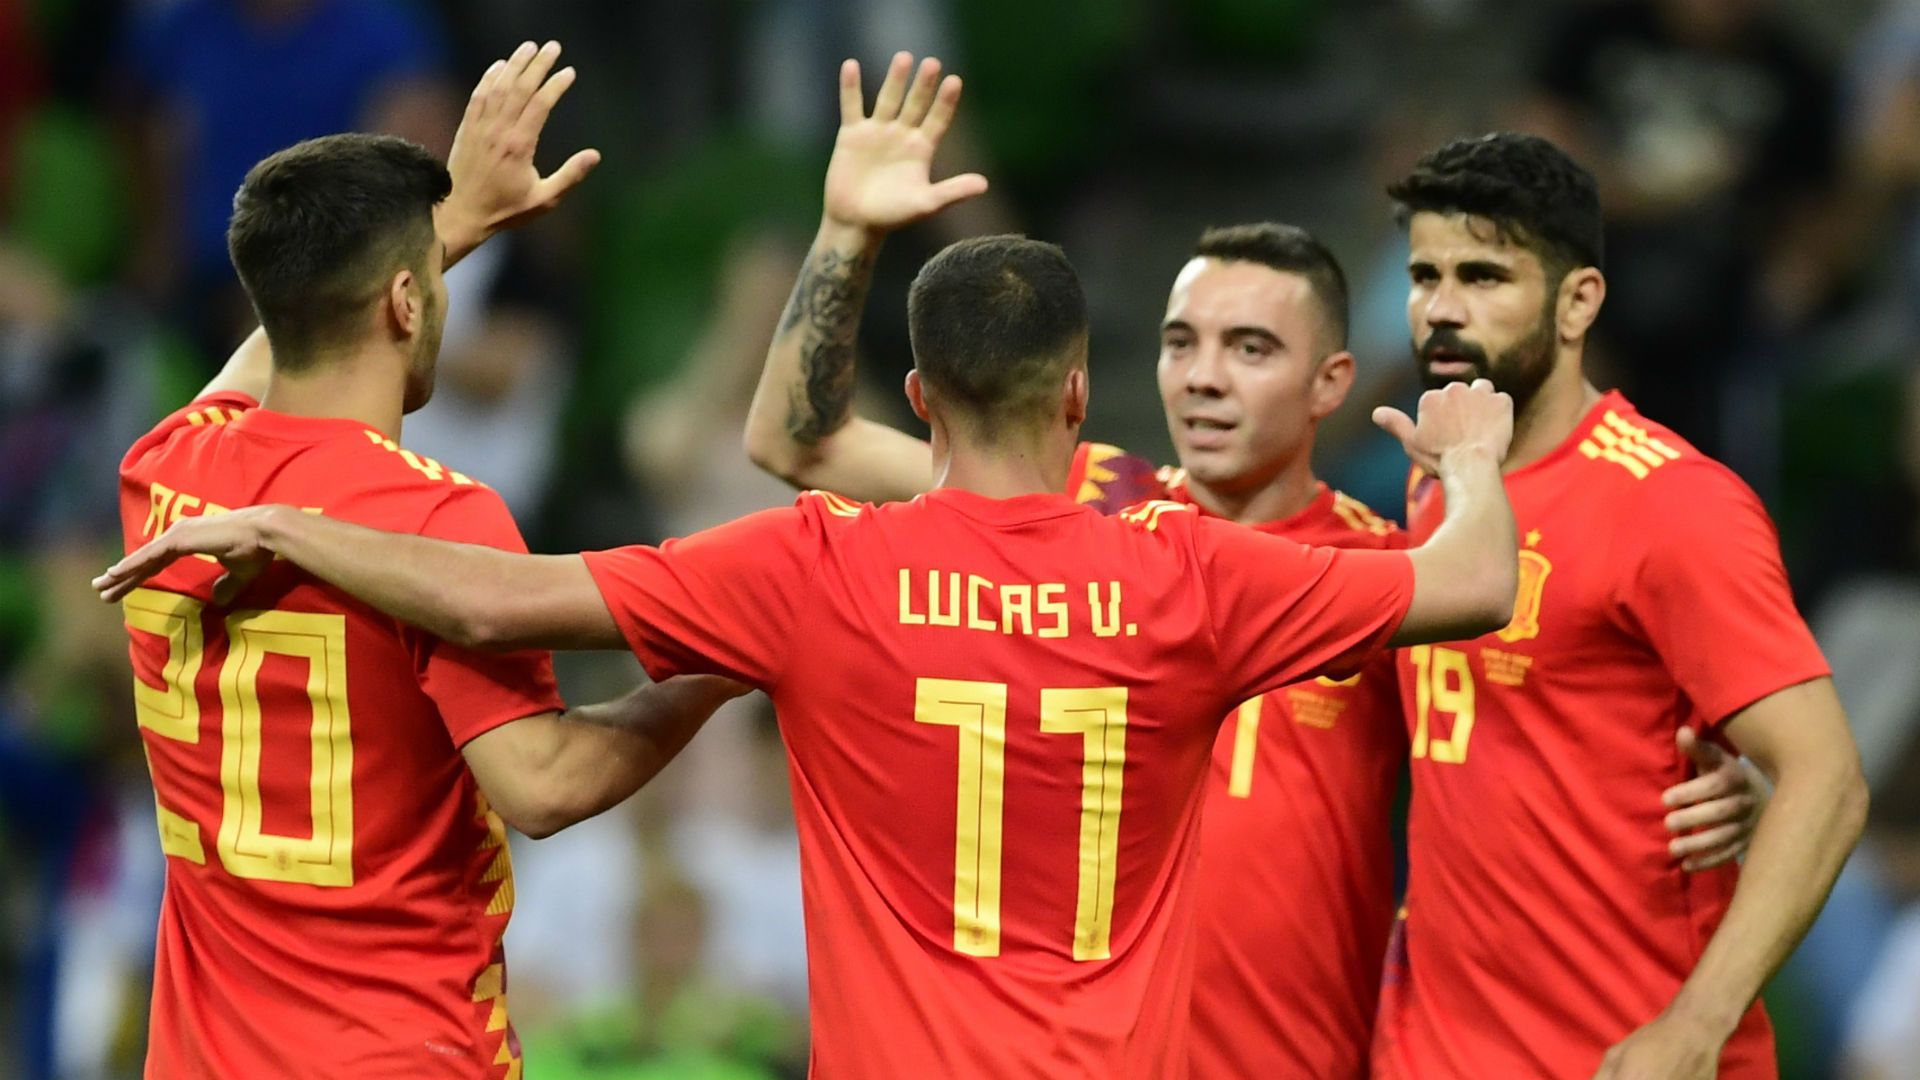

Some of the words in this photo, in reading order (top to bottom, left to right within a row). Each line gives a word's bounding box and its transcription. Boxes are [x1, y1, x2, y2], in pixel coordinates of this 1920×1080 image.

[898, 568, 1070, 639] LUCAS
[1087, 580, 1139, 638] V.
[1410, 644, 1476, 764] 19
[121, 587, 355, 888] 20
[914, 677, 1129, 962] 11
